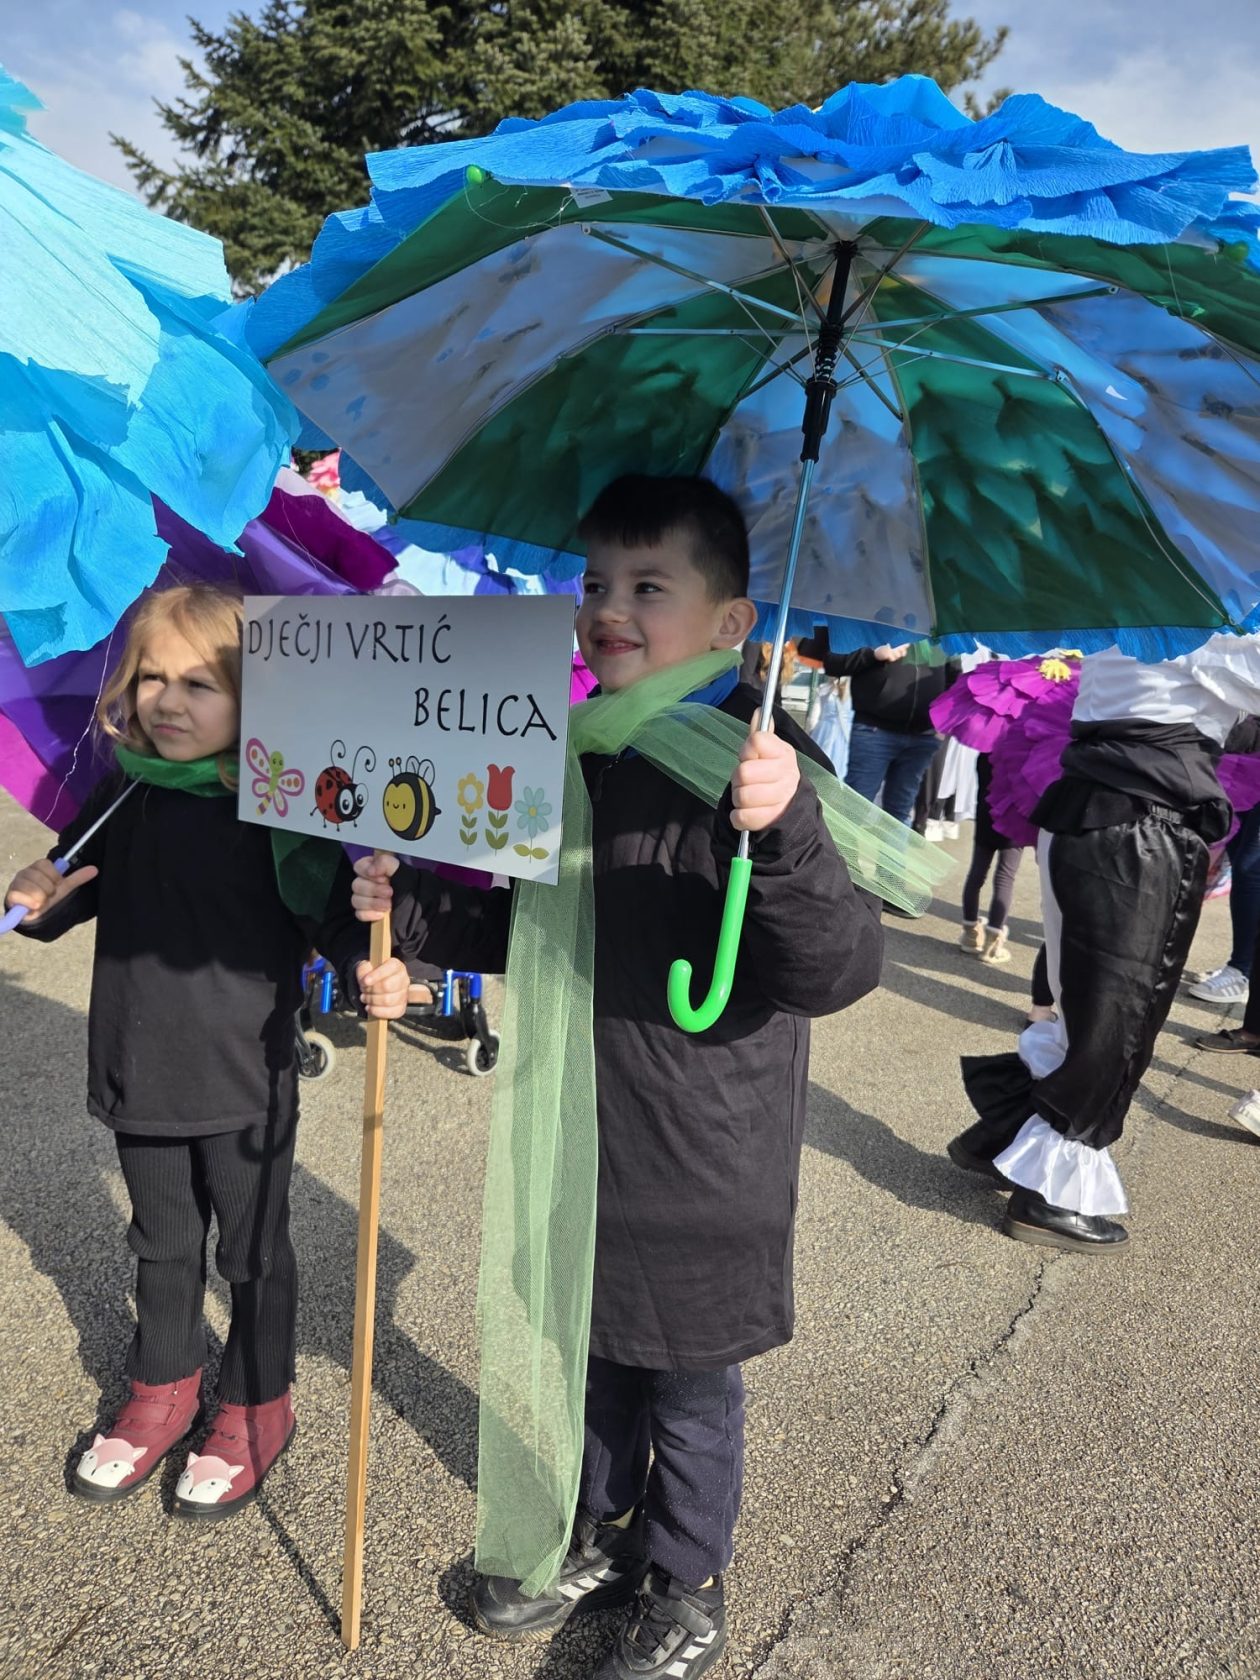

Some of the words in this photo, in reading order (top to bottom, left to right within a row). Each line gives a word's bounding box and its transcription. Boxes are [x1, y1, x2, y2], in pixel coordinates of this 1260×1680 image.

[248, 613, 333, 663] DJEČJI
[346, 614, 452, 664] VRTIĆ
[413, 687, 557, 741] BELICA
